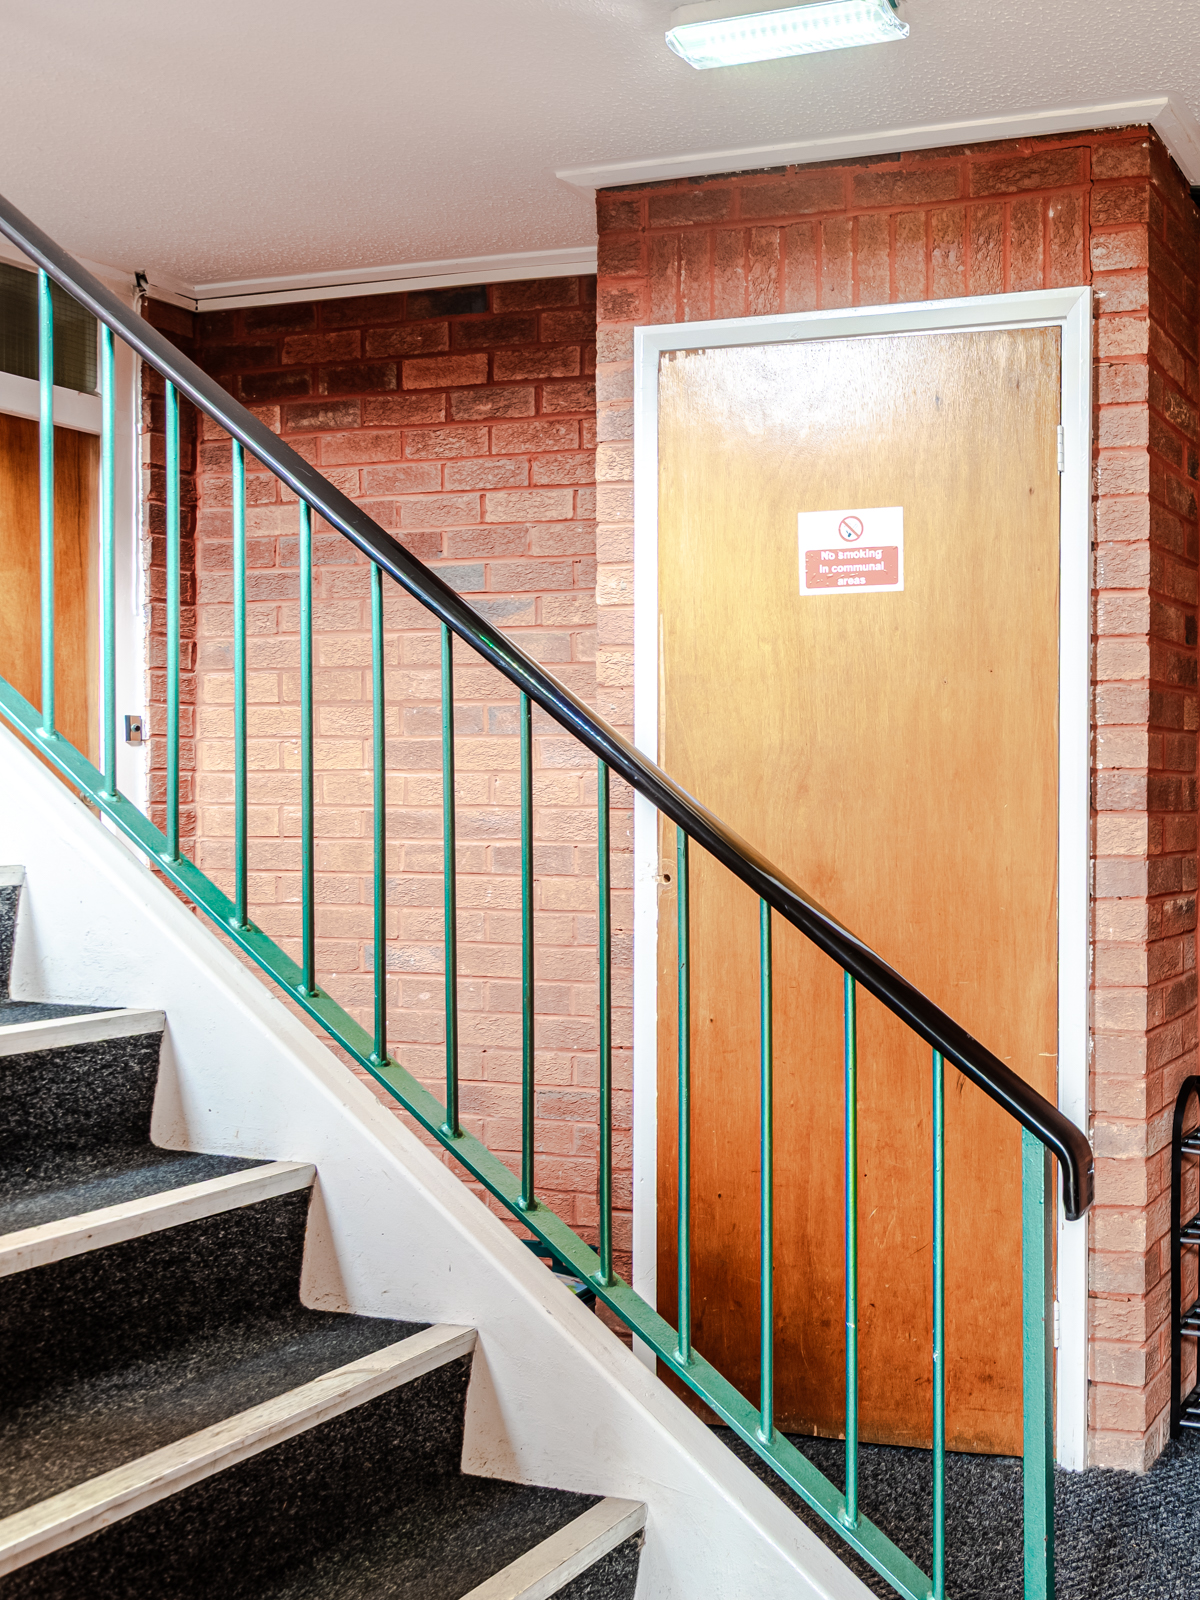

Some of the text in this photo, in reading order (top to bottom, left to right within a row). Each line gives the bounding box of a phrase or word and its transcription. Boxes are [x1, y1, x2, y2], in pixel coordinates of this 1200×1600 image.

[821, 549, 882, 560] No smoking
[831, 561, 884, 572] communal
[837, 576, 866, 586] areas
